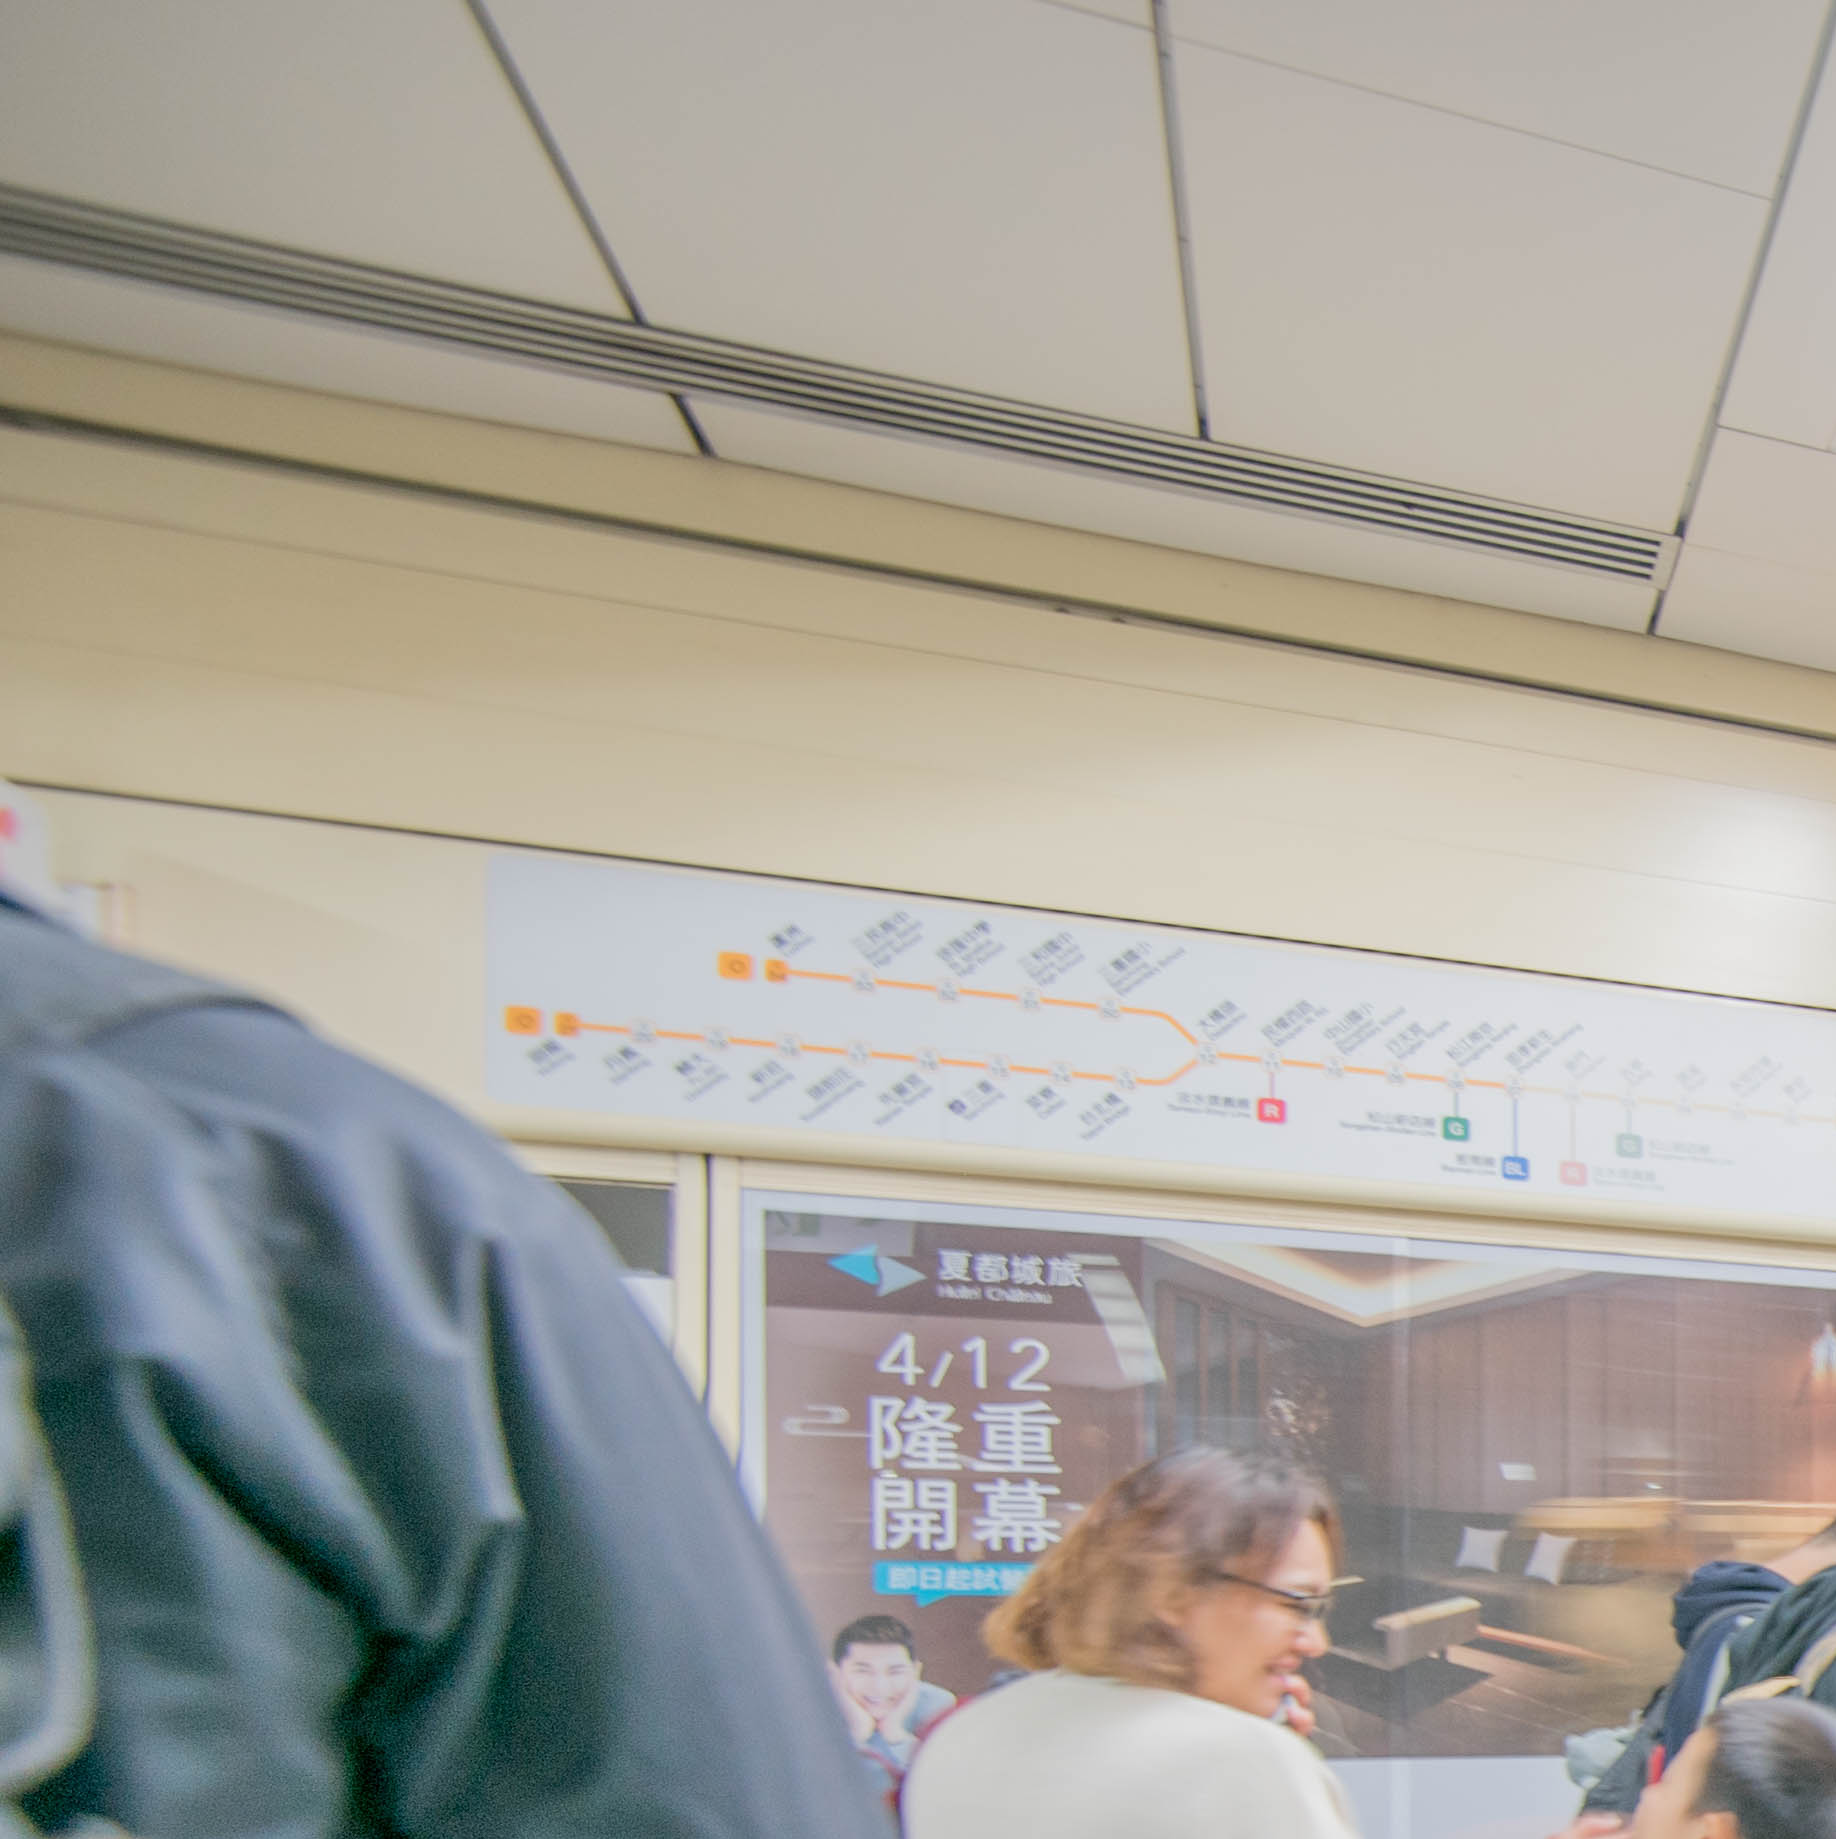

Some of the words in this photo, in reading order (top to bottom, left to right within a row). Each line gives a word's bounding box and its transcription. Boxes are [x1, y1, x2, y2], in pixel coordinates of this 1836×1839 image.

[937, 1248, 1084, 1288] 夏都城旅
[876, 1332, 1053, 1393] 4/12
[869, 1396, 1063, 1475] 隆重
[871, 1476, 1064, 1553] 開幕
